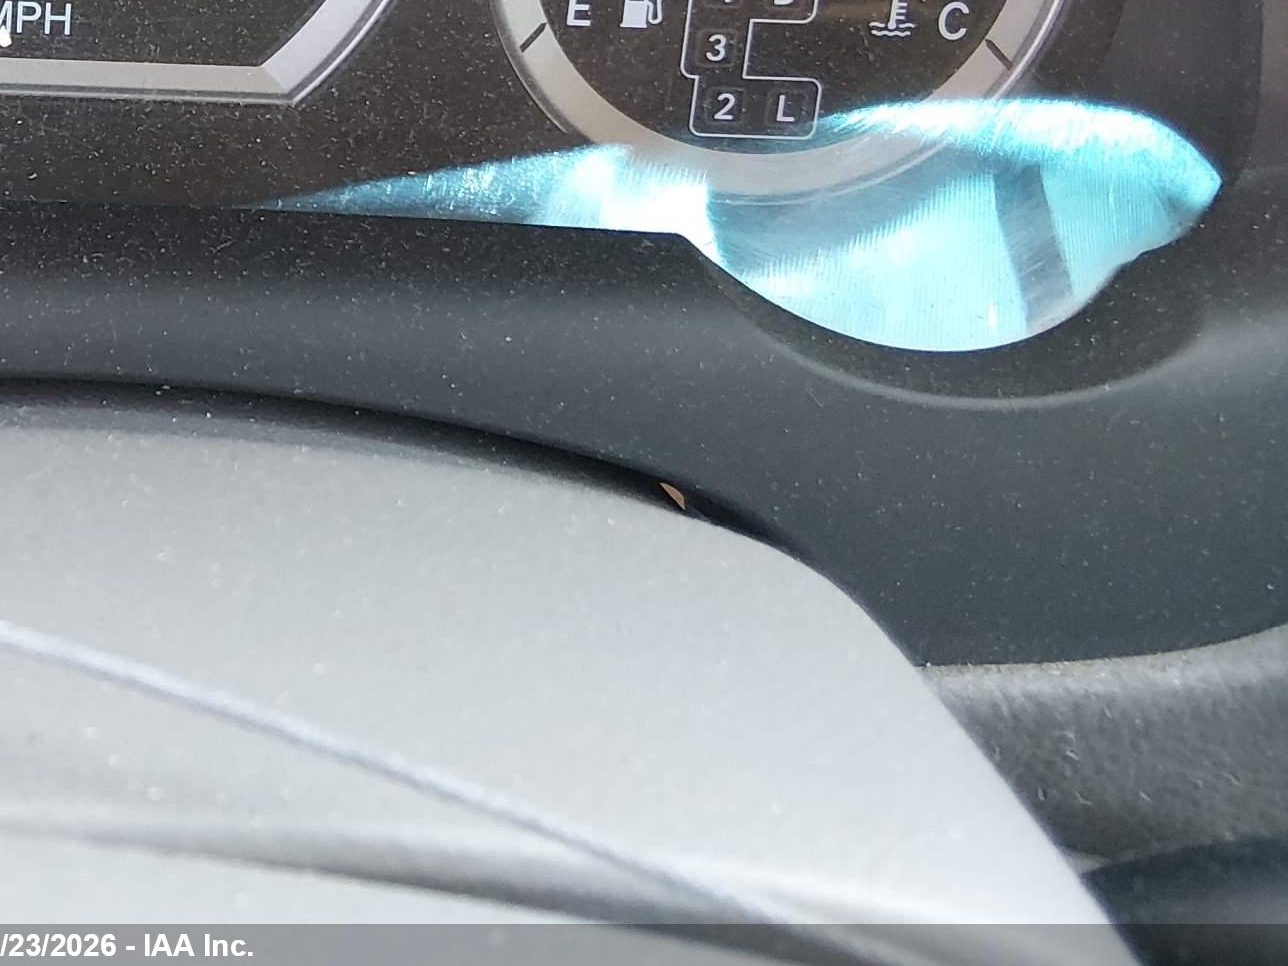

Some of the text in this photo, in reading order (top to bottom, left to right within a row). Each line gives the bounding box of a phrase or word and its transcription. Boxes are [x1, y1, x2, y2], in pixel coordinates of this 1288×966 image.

[938, 1, 970, 41] C
[706, 34, 727, 61] 3
[714, 93, 736, 120] 2
[776, 94, 795, 122] L
